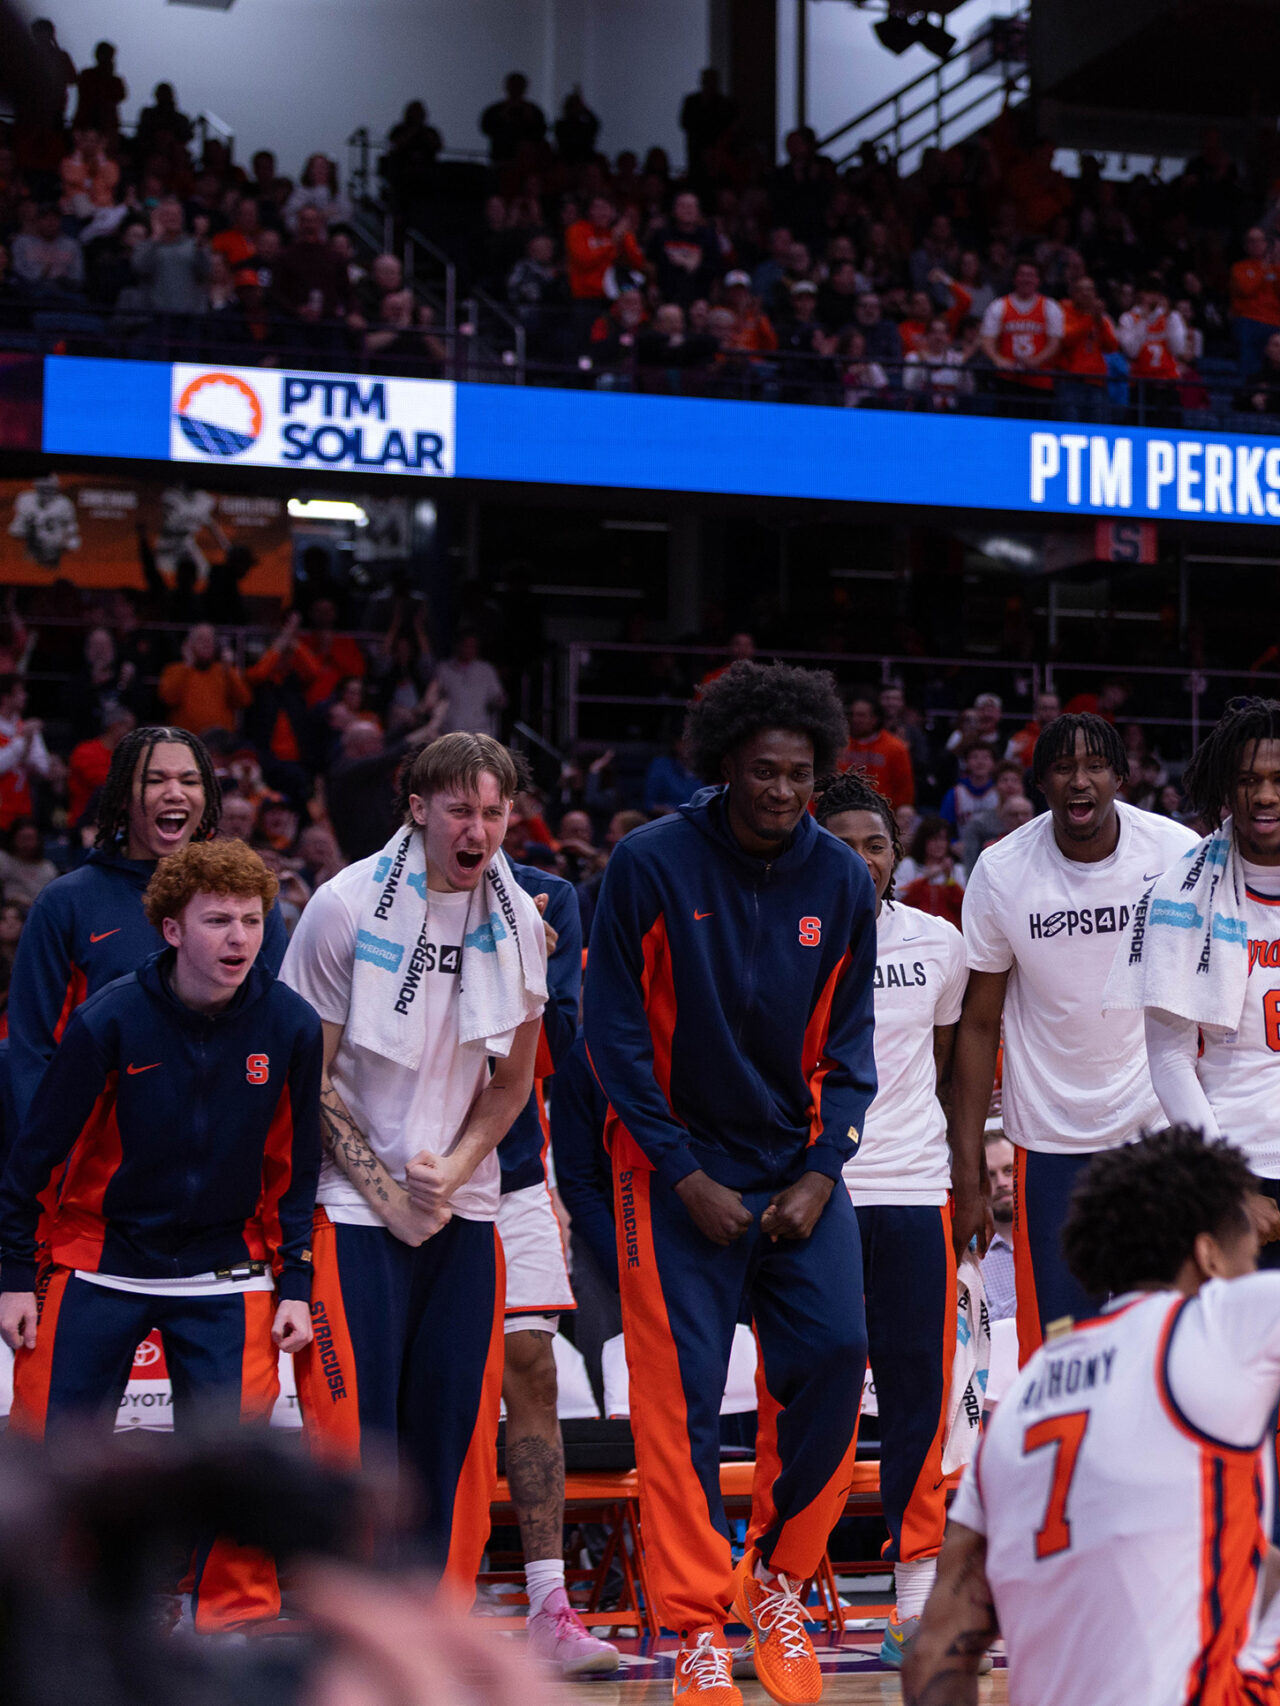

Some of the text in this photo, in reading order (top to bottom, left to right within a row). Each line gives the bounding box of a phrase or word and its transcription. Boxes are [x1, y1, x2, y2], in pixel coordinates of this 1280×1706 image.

[283, 377, 386, 421] PTM
[283, 423, 444, 470] SOLAR
[1030, 432, 1132, 508] PTM
[799, 917, 821, 946] S
[246, 1054, 269, 1084] S
[620, 1170, 640, 1270] SYRACUSE
[311, 1300, 348, 1404] SYRACUSE
[1022, 1408, 1092, 1563] 7
